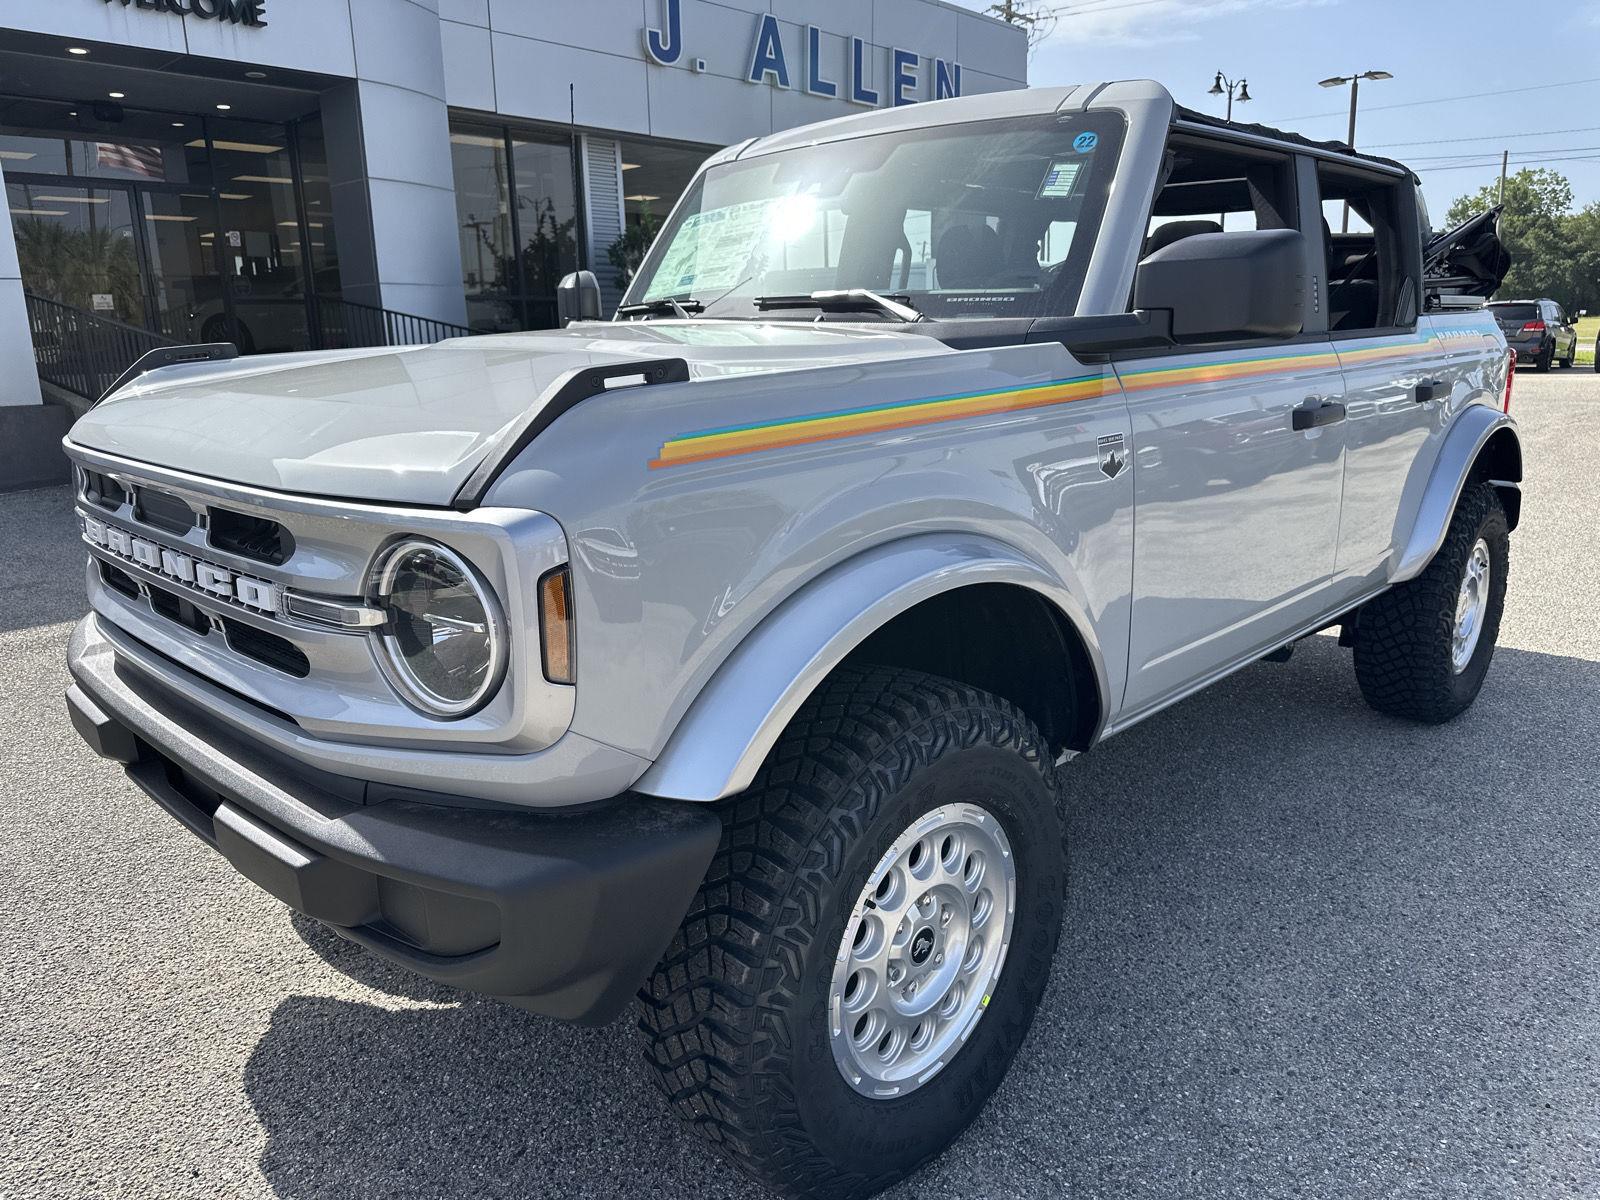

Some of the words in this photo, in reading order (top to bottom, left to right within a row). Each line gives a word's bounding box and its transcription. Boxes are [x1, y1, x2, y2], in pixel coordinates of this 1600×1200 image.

[104, 0, 268, 28] COME
[746, 13, 963, 107] ALLEN
[1076, 135, 1097, 149] 22
[85, 517, 277, 612] BRONCO
